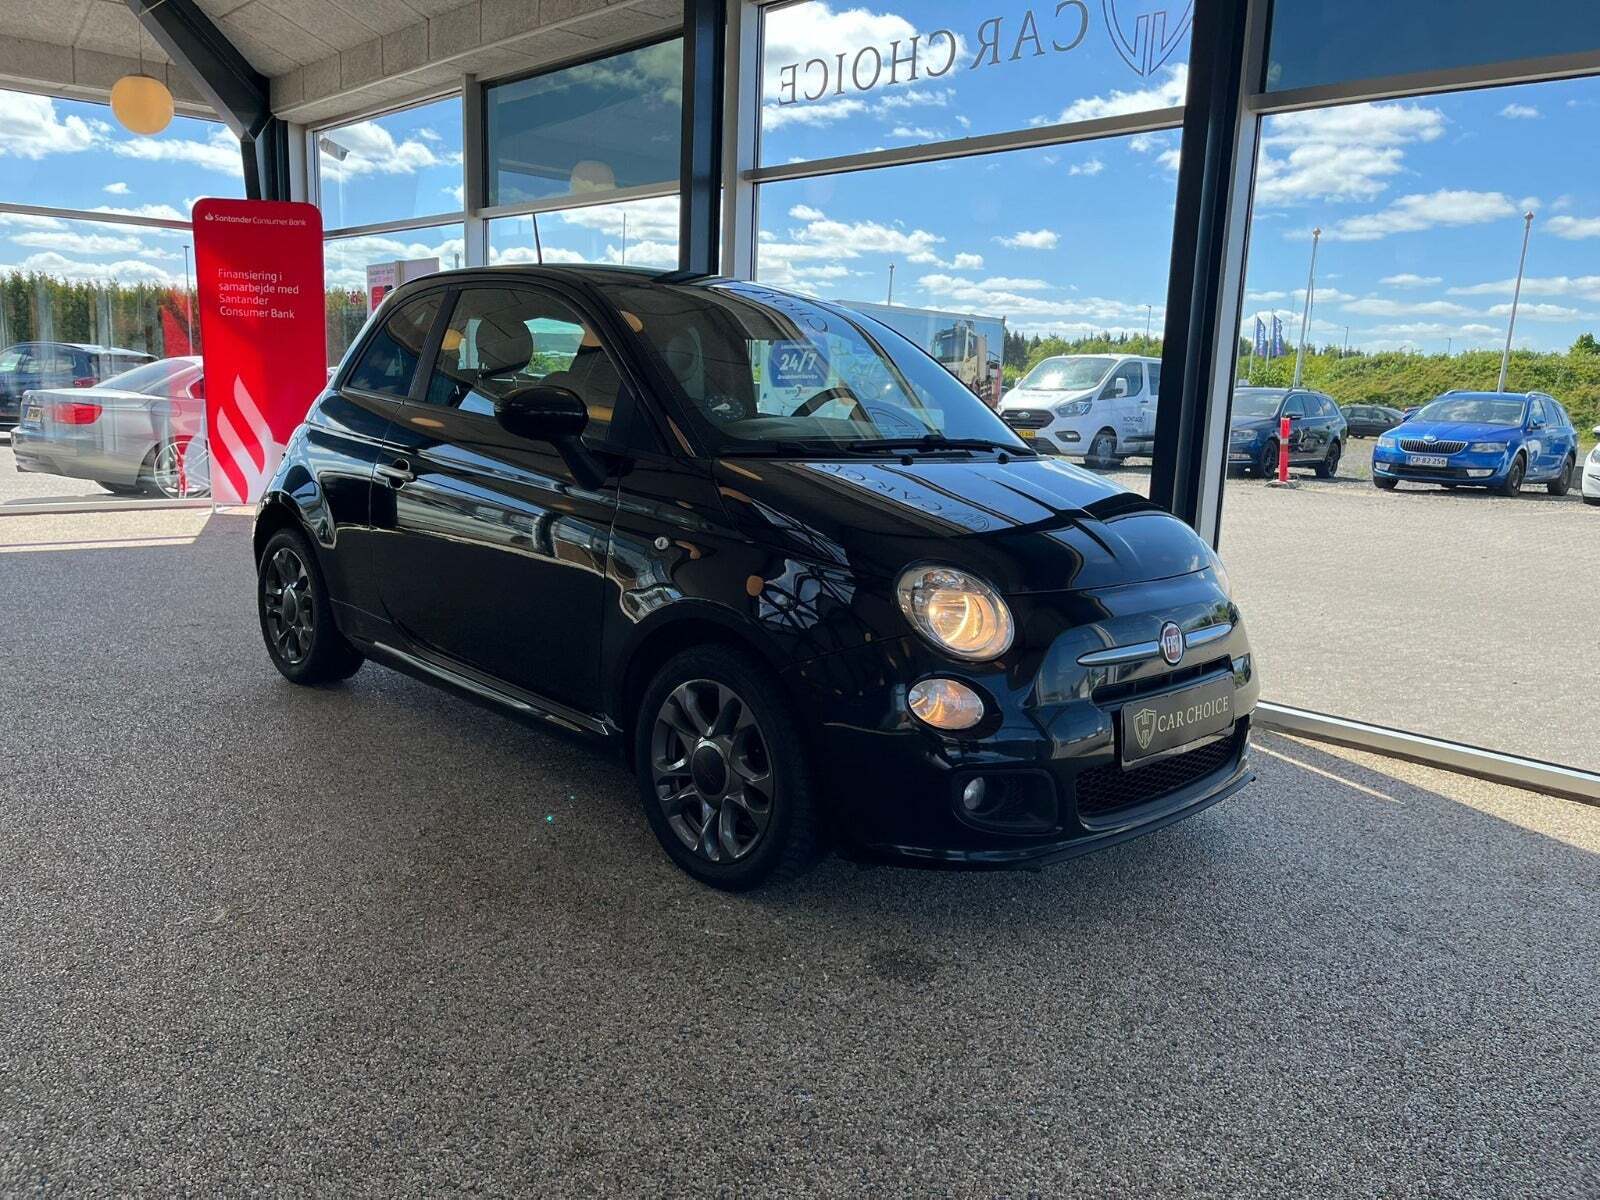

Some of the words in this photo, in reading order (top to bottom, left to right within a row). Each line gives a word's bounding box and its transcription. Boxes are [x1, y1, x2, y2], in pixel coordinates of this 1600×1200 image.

[214, 214, 252, 224] Santander
[252, 216, 288, 226] Consumer
[288, 218, 306, 227] Bank
[218, 268, 277, 283] Finansiering
[218, 282, 276, 295] samarbejde
[277, 284, 299, 295] med
[219, 294, 269, 305] Santander
[220, 306, 268, 318] Consumer
[270, 308, 295, 319] Bank
[780, 351, 817, 372] 24/7
[1157, 711, 1184, 733] CAR
[1186, 696, 1229, 724] CHOICE
